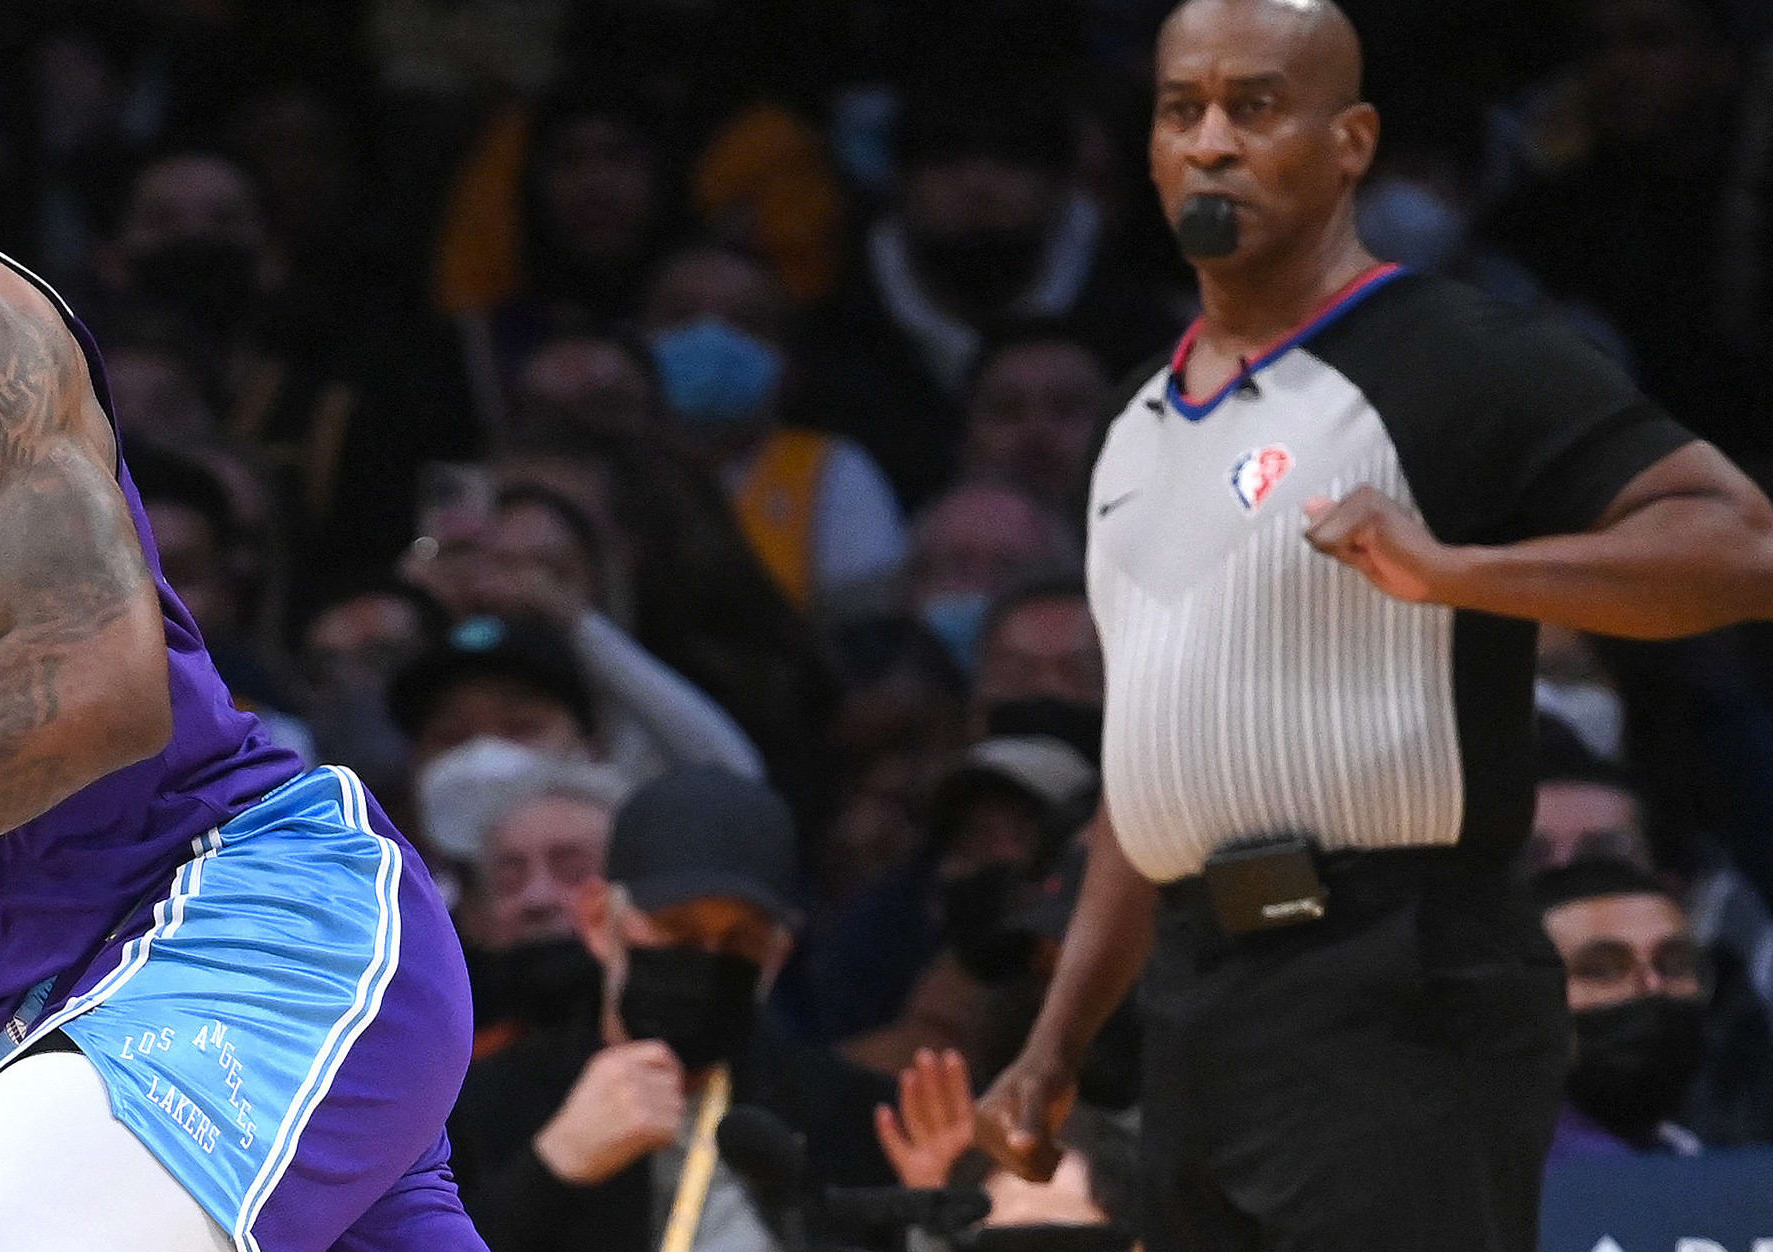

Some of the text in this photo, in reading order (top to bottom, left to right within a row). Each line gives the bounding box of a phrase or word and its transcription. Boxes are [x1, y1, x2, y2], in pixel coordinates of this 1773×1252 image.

[120, 1019, 257, 1149] LOS ANGELES
[144, 1075, 221, 1154] LAKERS
